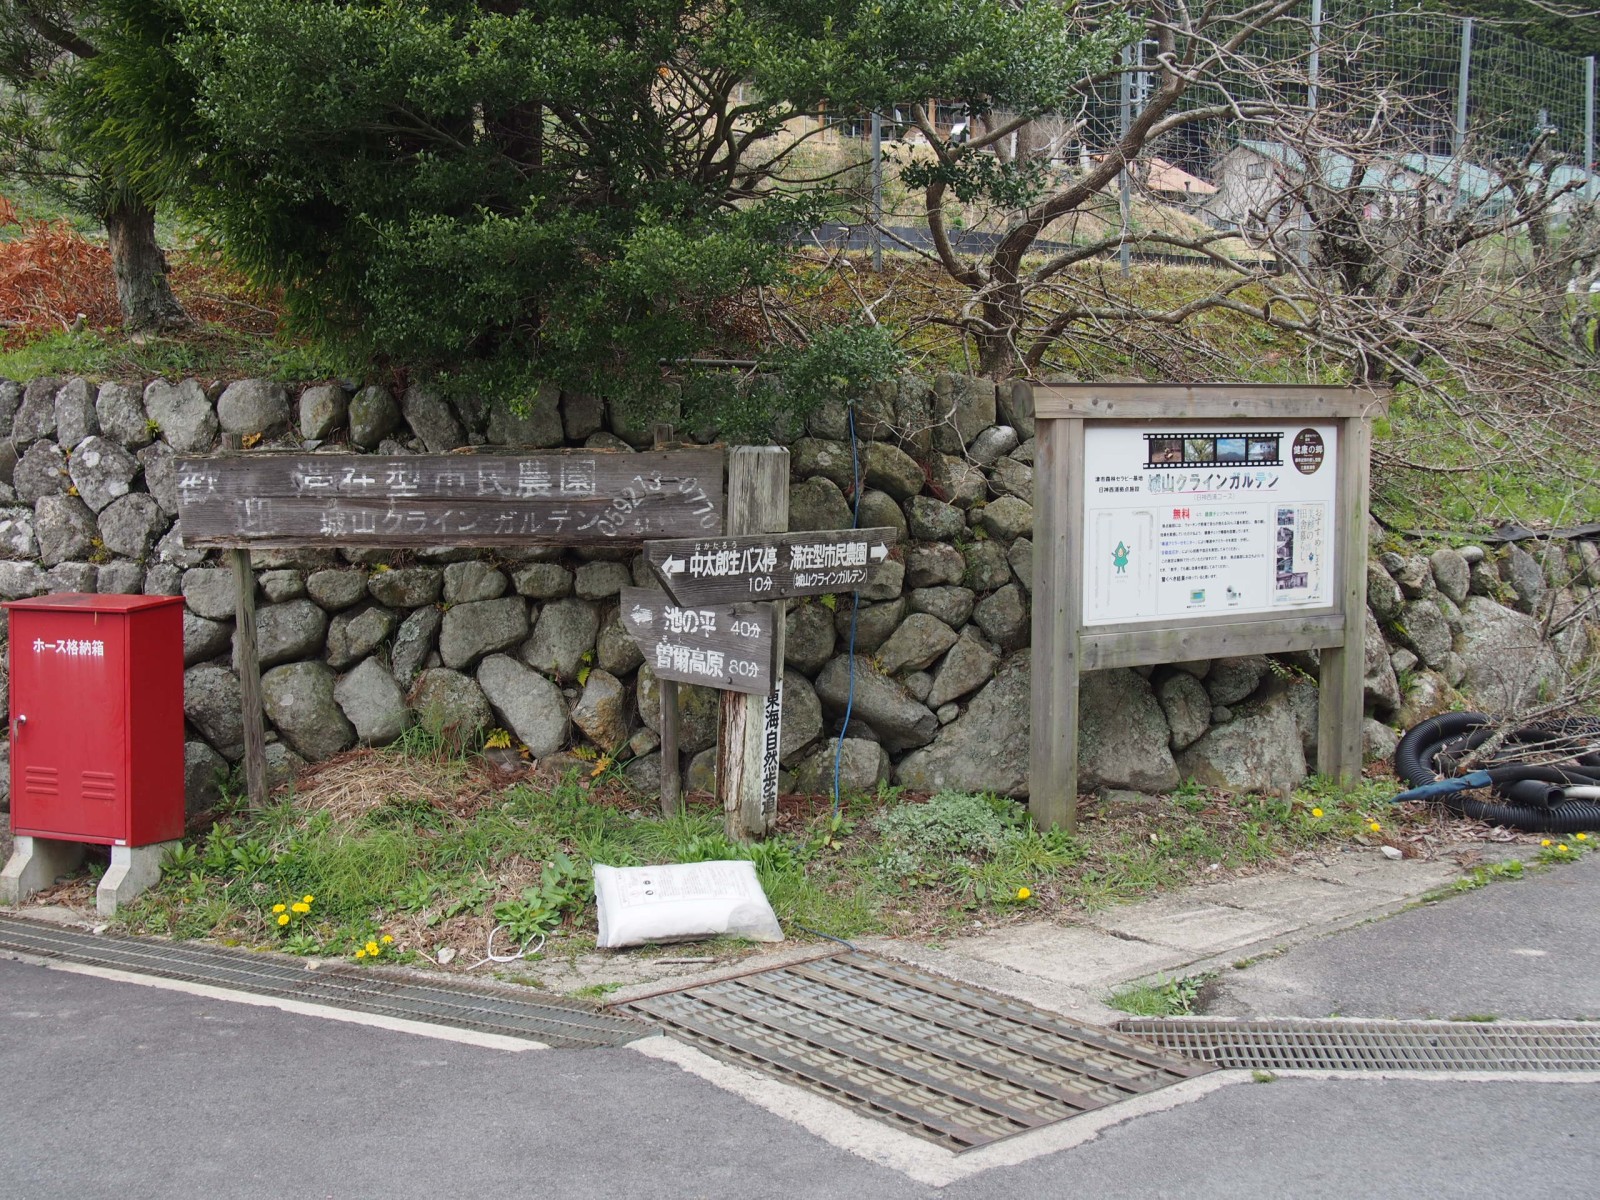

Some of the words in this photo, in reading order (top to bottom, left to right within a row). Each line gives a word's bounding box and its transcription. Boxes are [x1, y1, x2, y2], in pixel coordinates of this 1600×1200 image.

[1149, 472, 1280, 493] 城山クラインガルテン
[1173, 508, 1190, 519] 無料
[689, 547, 778, 578] 中太郎生バス停
[789, 542, 868, 571] 滞在型市民農園
[748, 576, 773, 592] 10分
[663, 606, 717, 638] 池の平
[730, 620, 761, 638] 40分
[33, 638, 104, 656] ホース格納箱
[728, 658, 759, 678] 80分
[761, 690, 780, 816] 東海自然歩道
